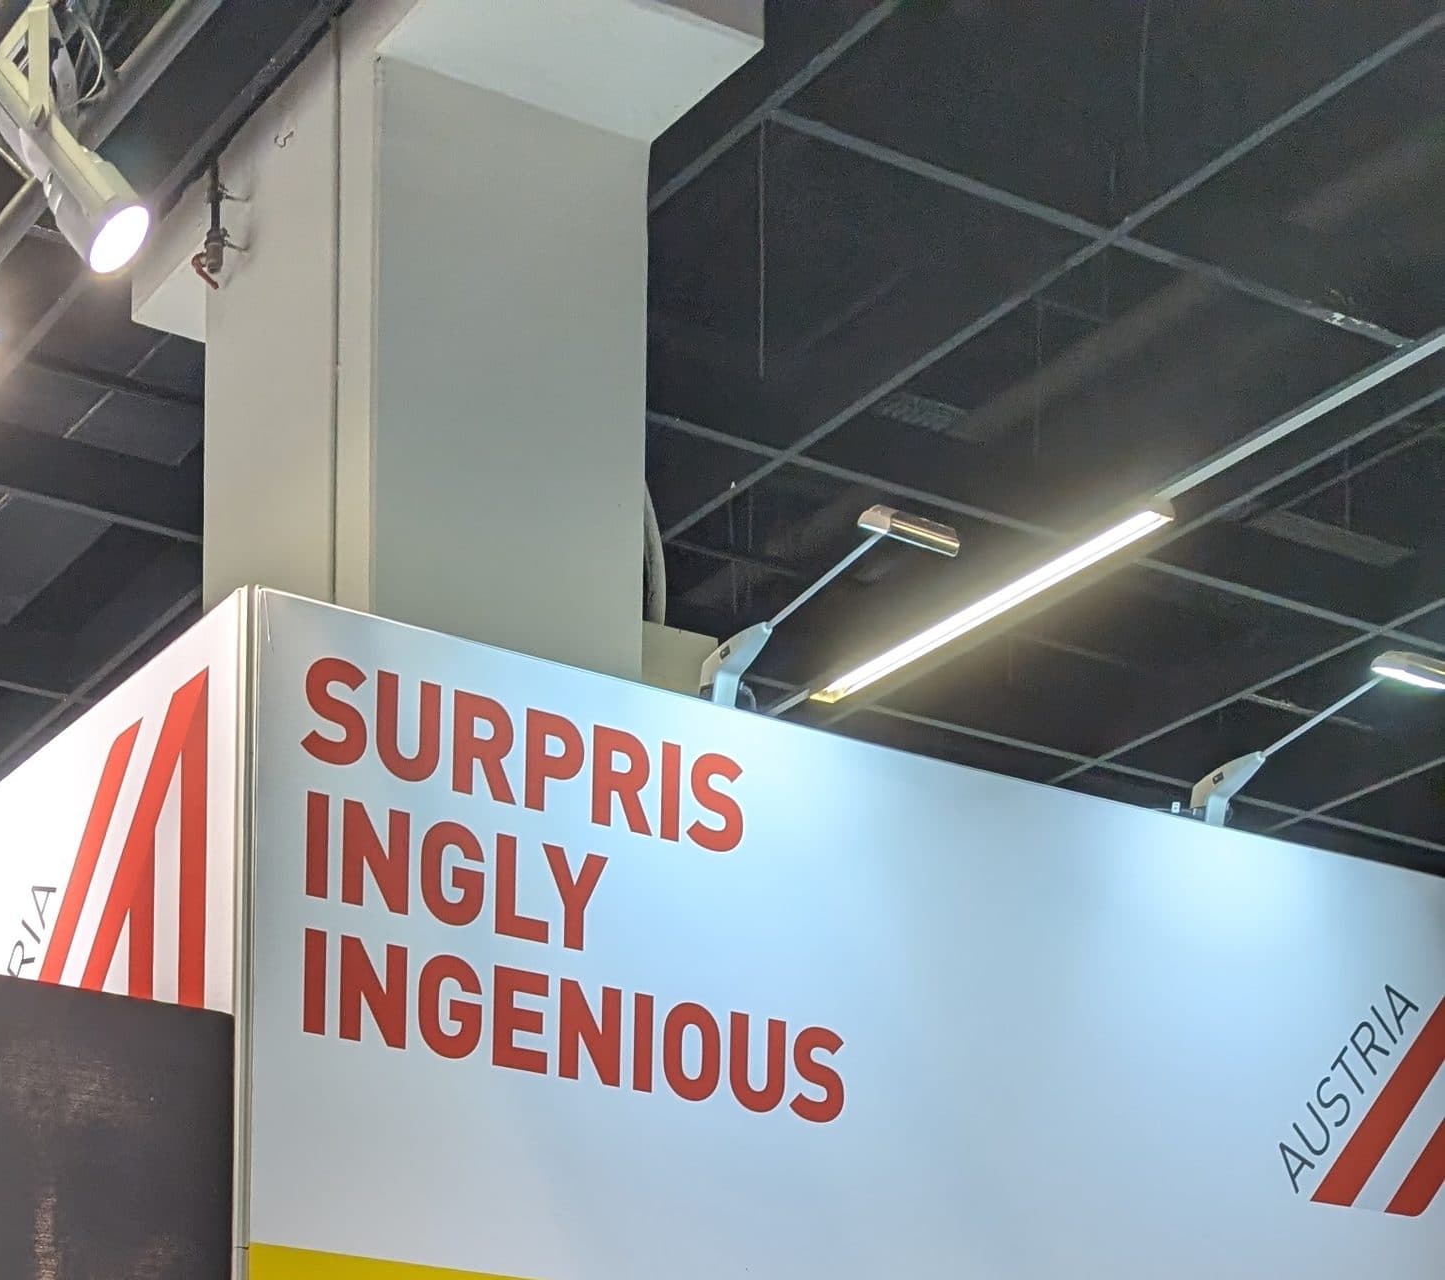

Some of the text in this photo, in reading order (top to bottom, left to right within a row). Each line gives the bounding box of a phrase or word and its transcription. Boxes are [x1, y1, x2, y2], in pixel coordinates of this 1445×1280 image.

[301, 657, 743, 852] SURPRIS
[305, 790, 607, 952] INGLY
[303, 927, 845, 1123] INGENIOUS
[1278, 984, 1419, 1194] AUSTRIA
